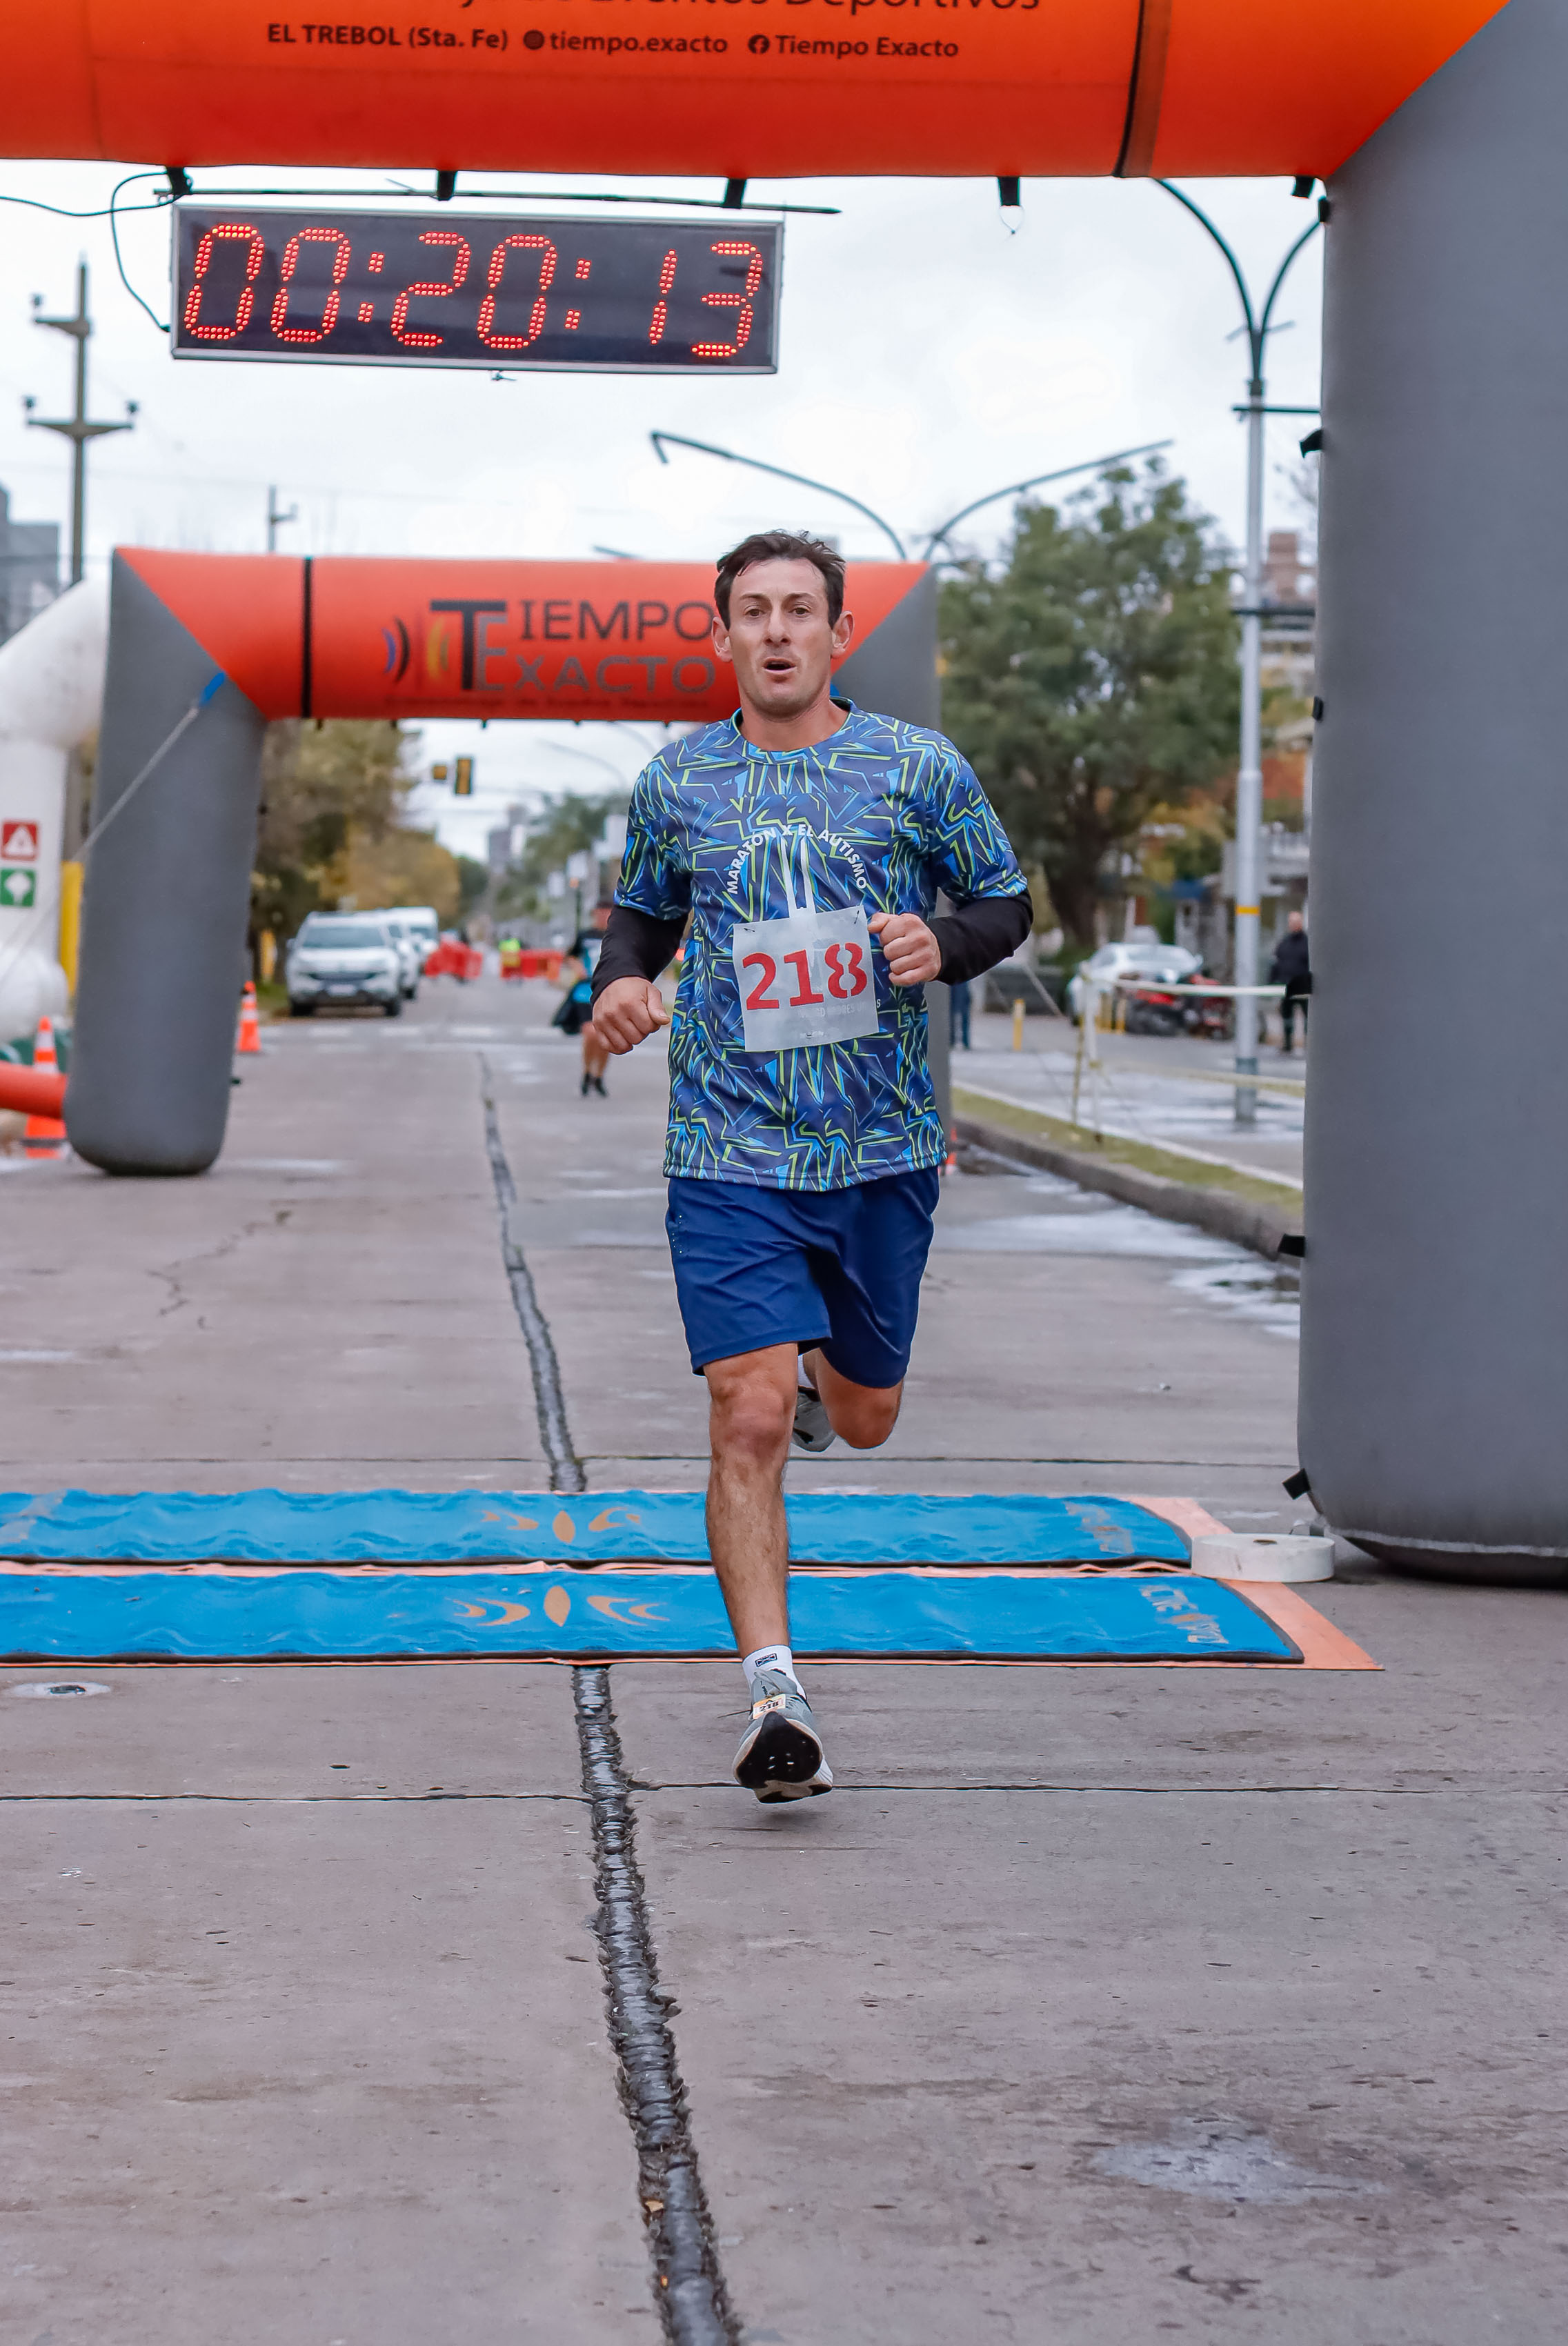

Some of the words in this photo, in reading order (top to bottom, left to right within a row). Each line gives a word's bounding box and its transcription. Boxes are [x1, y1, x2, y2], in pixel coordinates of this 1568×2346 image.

[268, 23, 295, 43] EL
[302, 24, 401, 46] TREBOL
[409, 26, 464, 49] (Sta.
[471, 28, 508, 51] Fe)
[550, 32, 728, 54] tiempo.exacto
[777, 34, 869, 59] Tiempo
[877, 37, 959, 58] Exacto
[727, 828, 777, 894] MARATÓN
[782, 825, 793, 835] X
[798, 824, 814, 837] EL
[817, 830, 866, 888] AUTISMO
[742, 942, 867, 1010] 218
